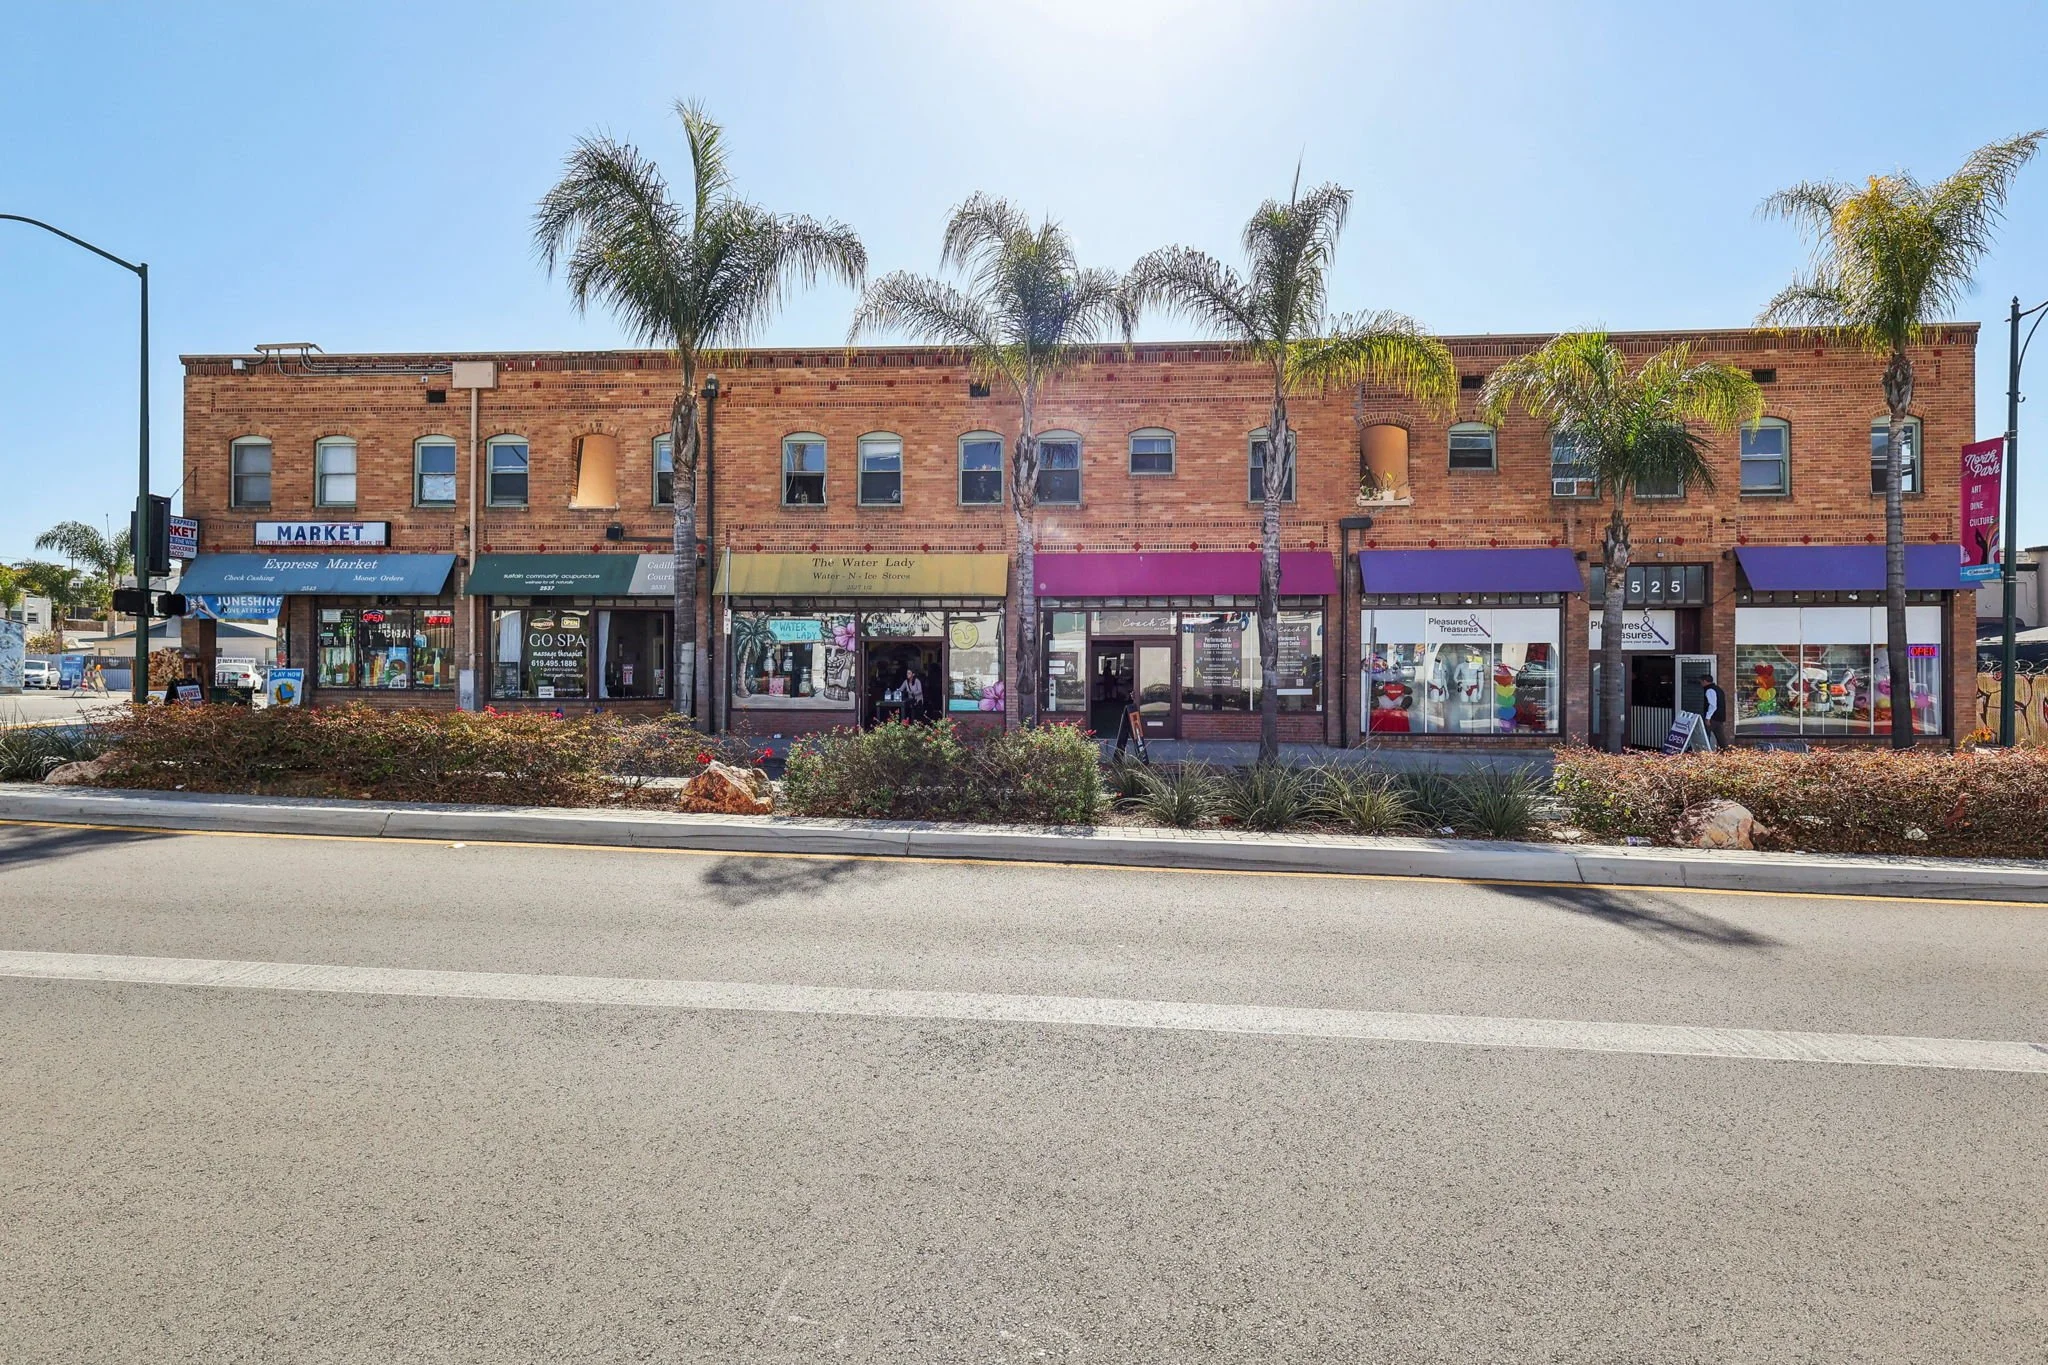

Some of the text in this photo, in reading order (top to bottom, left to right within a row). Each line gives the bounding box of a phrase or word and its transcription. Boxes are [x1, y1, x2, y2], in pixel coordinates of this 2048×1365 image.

[1965, 449, 1998, 466] North
[1971, 461, 2000, 477] Park
[1971, 485, 1982, 494] ART
[1970, 501, 1984, 510] DINE
[1969, 516, 1994, 527] CULTURE
[168, 525, 196, 538] RKET
[277, 526, 364, 540] MARKET
[264, 559, 378, 571] Express Market
[812, 558, 915, 569] The Water Lady
[812, 572, 840, 580] Water
[848, 572, 857, 580] N
[864, 572, 877, 580] Ice
[882, 572, 911, 580] Stores
[216, 596, 282, 606] JUNESHINE
[362, 613, 384, 623] OPEN
[1123, 618, 1157, 627] Coach
[779, 622, 807, 631] WATER
[1440, 625, 1478, 633] Treasures
[529, 633, 586, 647] GO SPA
[796, 631, 817, 640] LADY
[533, 649, 582, 659] massage therapist
[1911, 647, 1936, 656] OPEN
[270, 669, 286, 677] PLAY
[1668, 734, 1686, 744] OPEN
